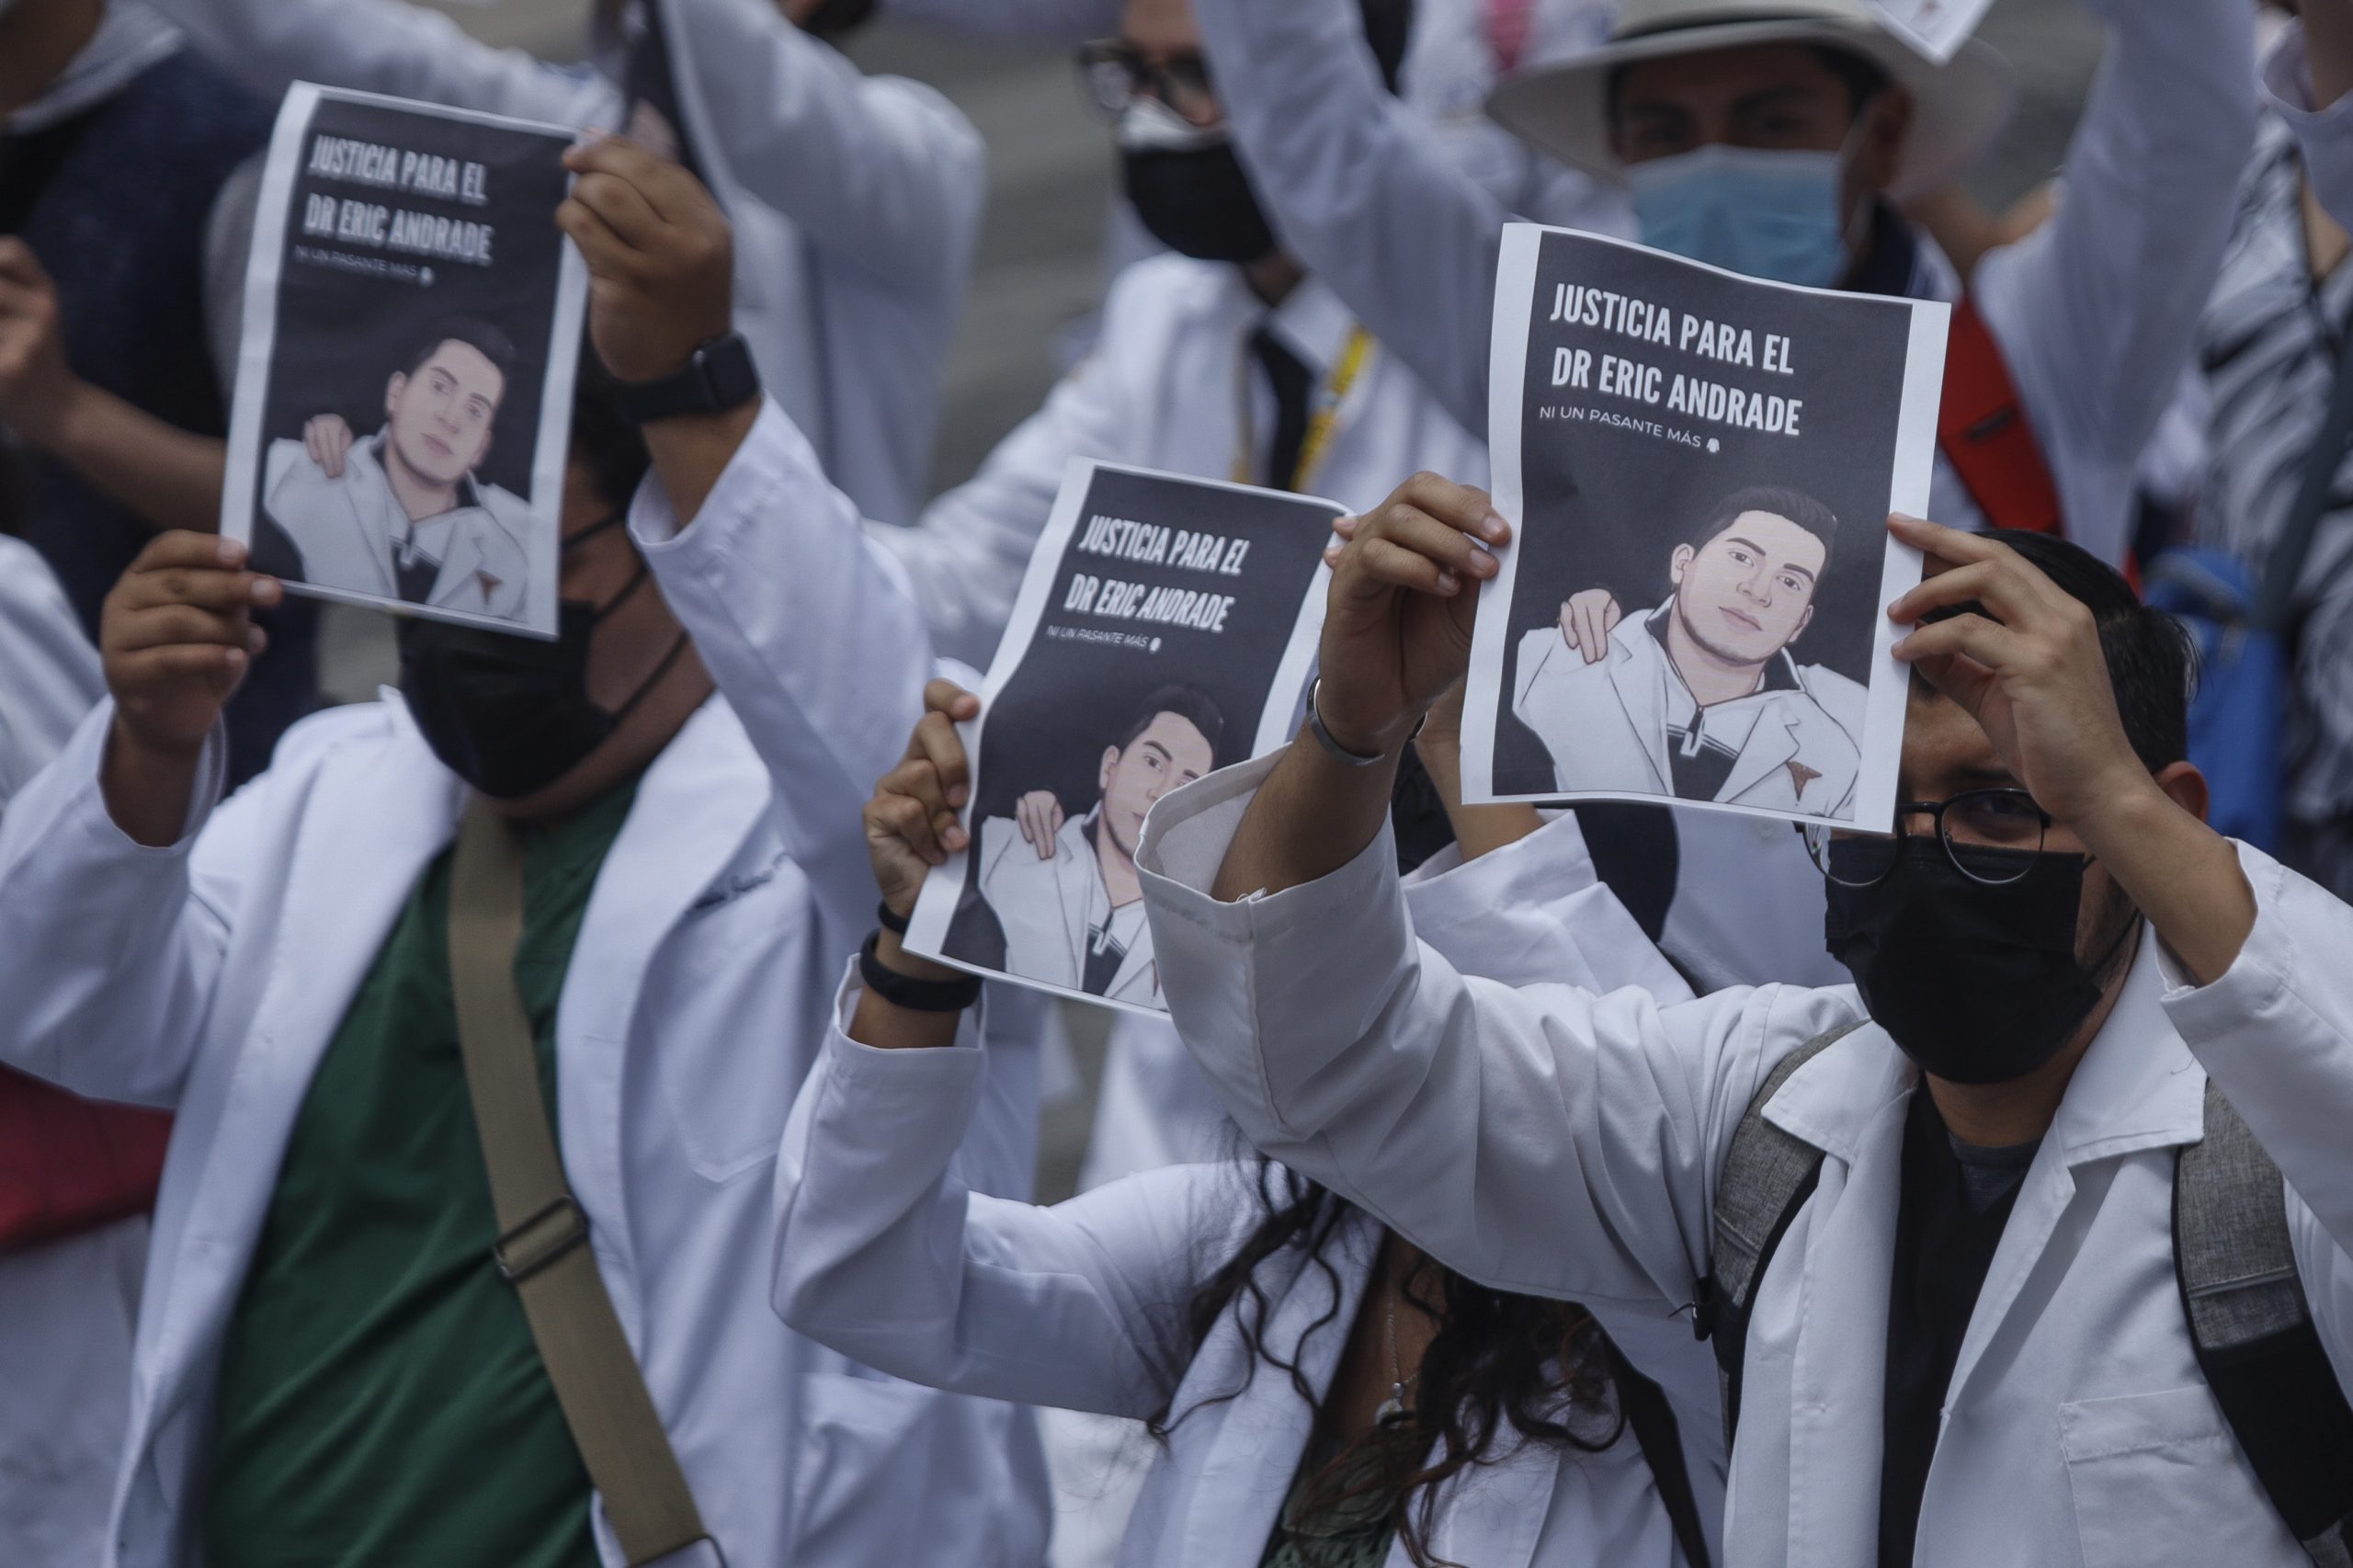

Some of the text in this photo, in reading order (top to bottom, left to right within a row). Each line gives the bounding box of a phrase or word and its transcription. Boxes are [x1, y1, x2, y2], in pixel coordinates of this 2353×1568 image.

[308, 134, 488, 205] JUSTICIA PARA EL
[303, 192, 494, 266] DR ERIC ANDRADE
[1550, 282, 1794, 374] JUSTICIA PARA EL
[1552, 347, 1802, 436] DR ERIC ANDRADE
[1539, 406, 1701, 448] NI UN PASANTE MÁS
[1078, 514, 1250, 576] JUSTICIA PARA EL
[1063, 573, 1235, 633] DR ERIC ANDRADE
[1077, 629, 1124, 644] PASANTE
